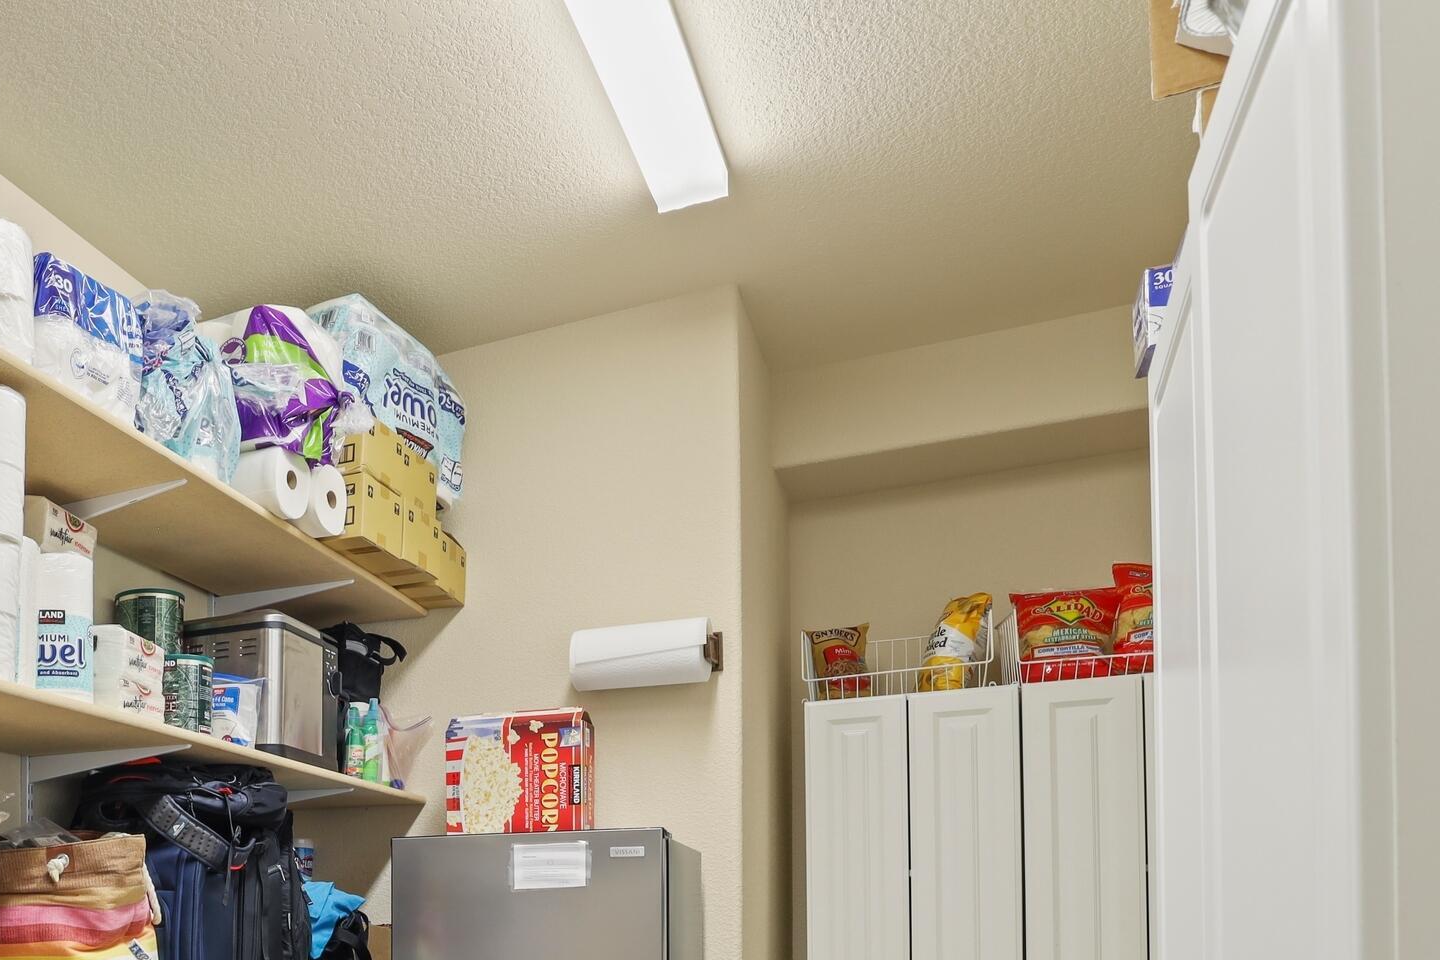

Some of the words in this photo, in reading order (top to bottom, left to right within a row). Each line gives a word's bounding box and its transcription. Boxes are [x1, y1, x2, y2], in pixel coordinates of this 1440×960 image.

[55, 274, 73, 293] 30
[1153, 269, 1174, 286] 30
[39, 611, 64, 619] LAND
[1032, 600, 1104, 621] CALIDAD
[39, 634, 66, 642] MIUM
[38, 638, 86, 666] wel
